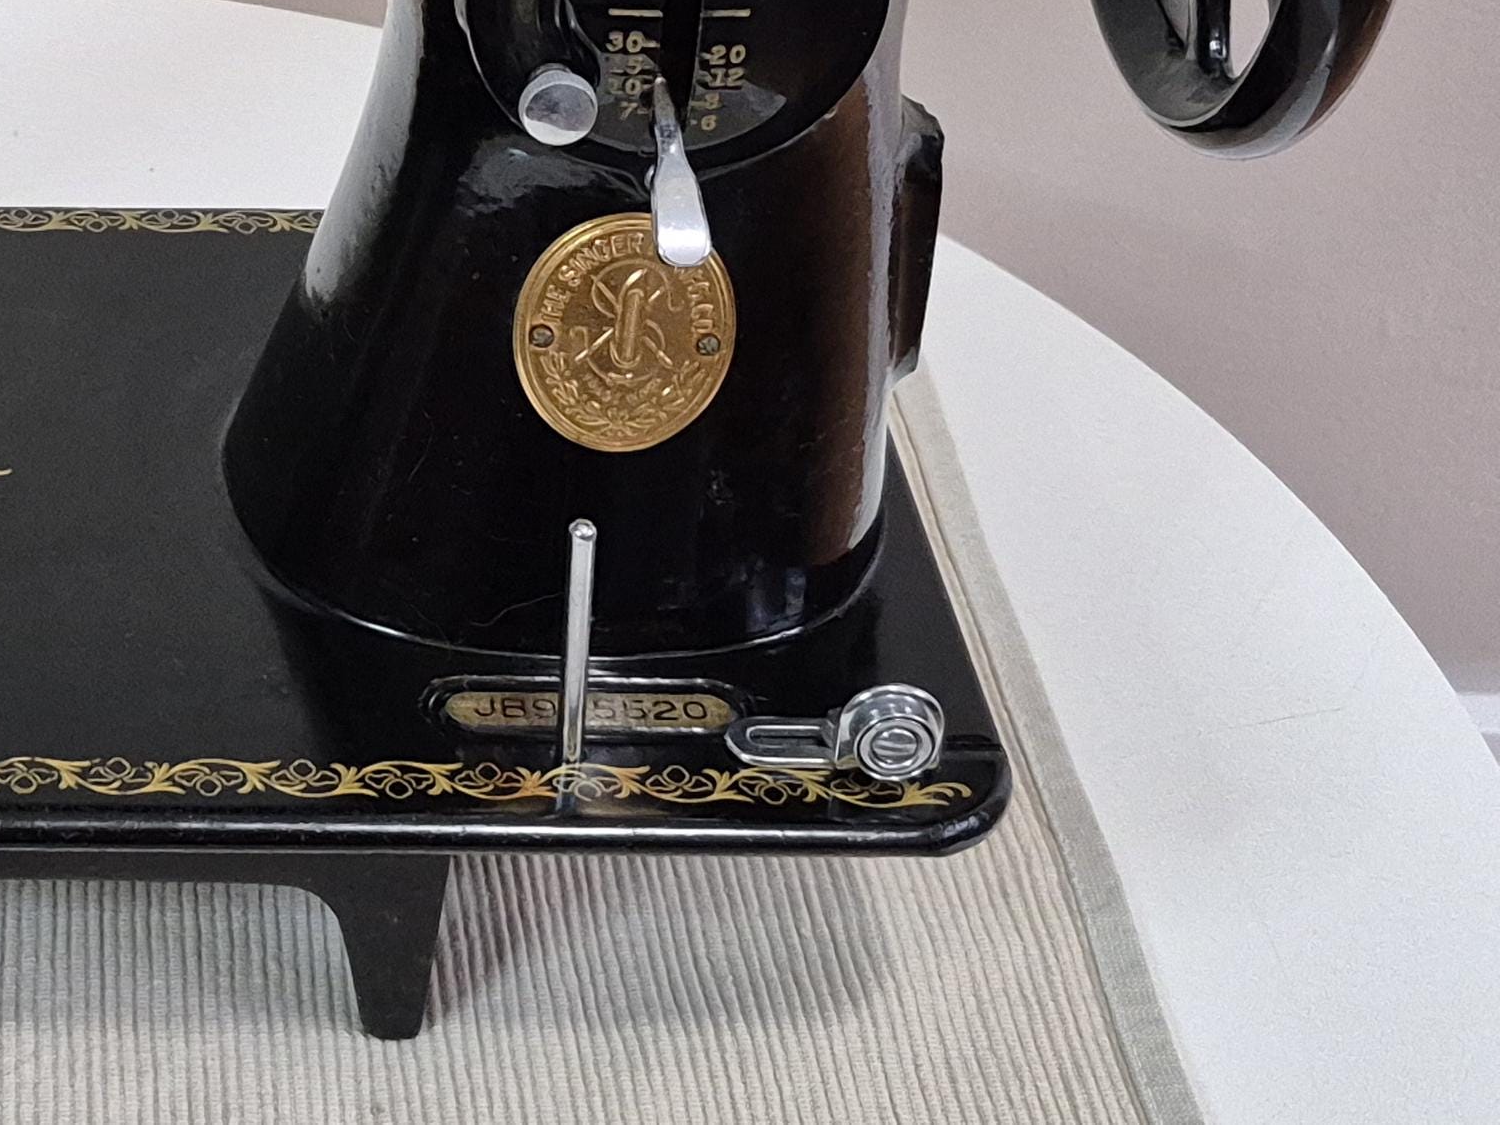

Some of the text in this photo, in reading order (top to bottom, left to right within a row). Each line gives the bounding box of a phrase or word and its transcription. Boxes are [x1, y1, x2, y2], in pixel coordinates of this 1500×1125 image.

[605, 31, 643, 53] 30
[709, 44, 746, 64] 20
[708, 67, 745, 87] 12
[701, 115, 716, 131] 6
[540, 285, 573, 324] THE
[558, 232, 645, 287] SINGER
[474, 696, 708, 721] JB95520
